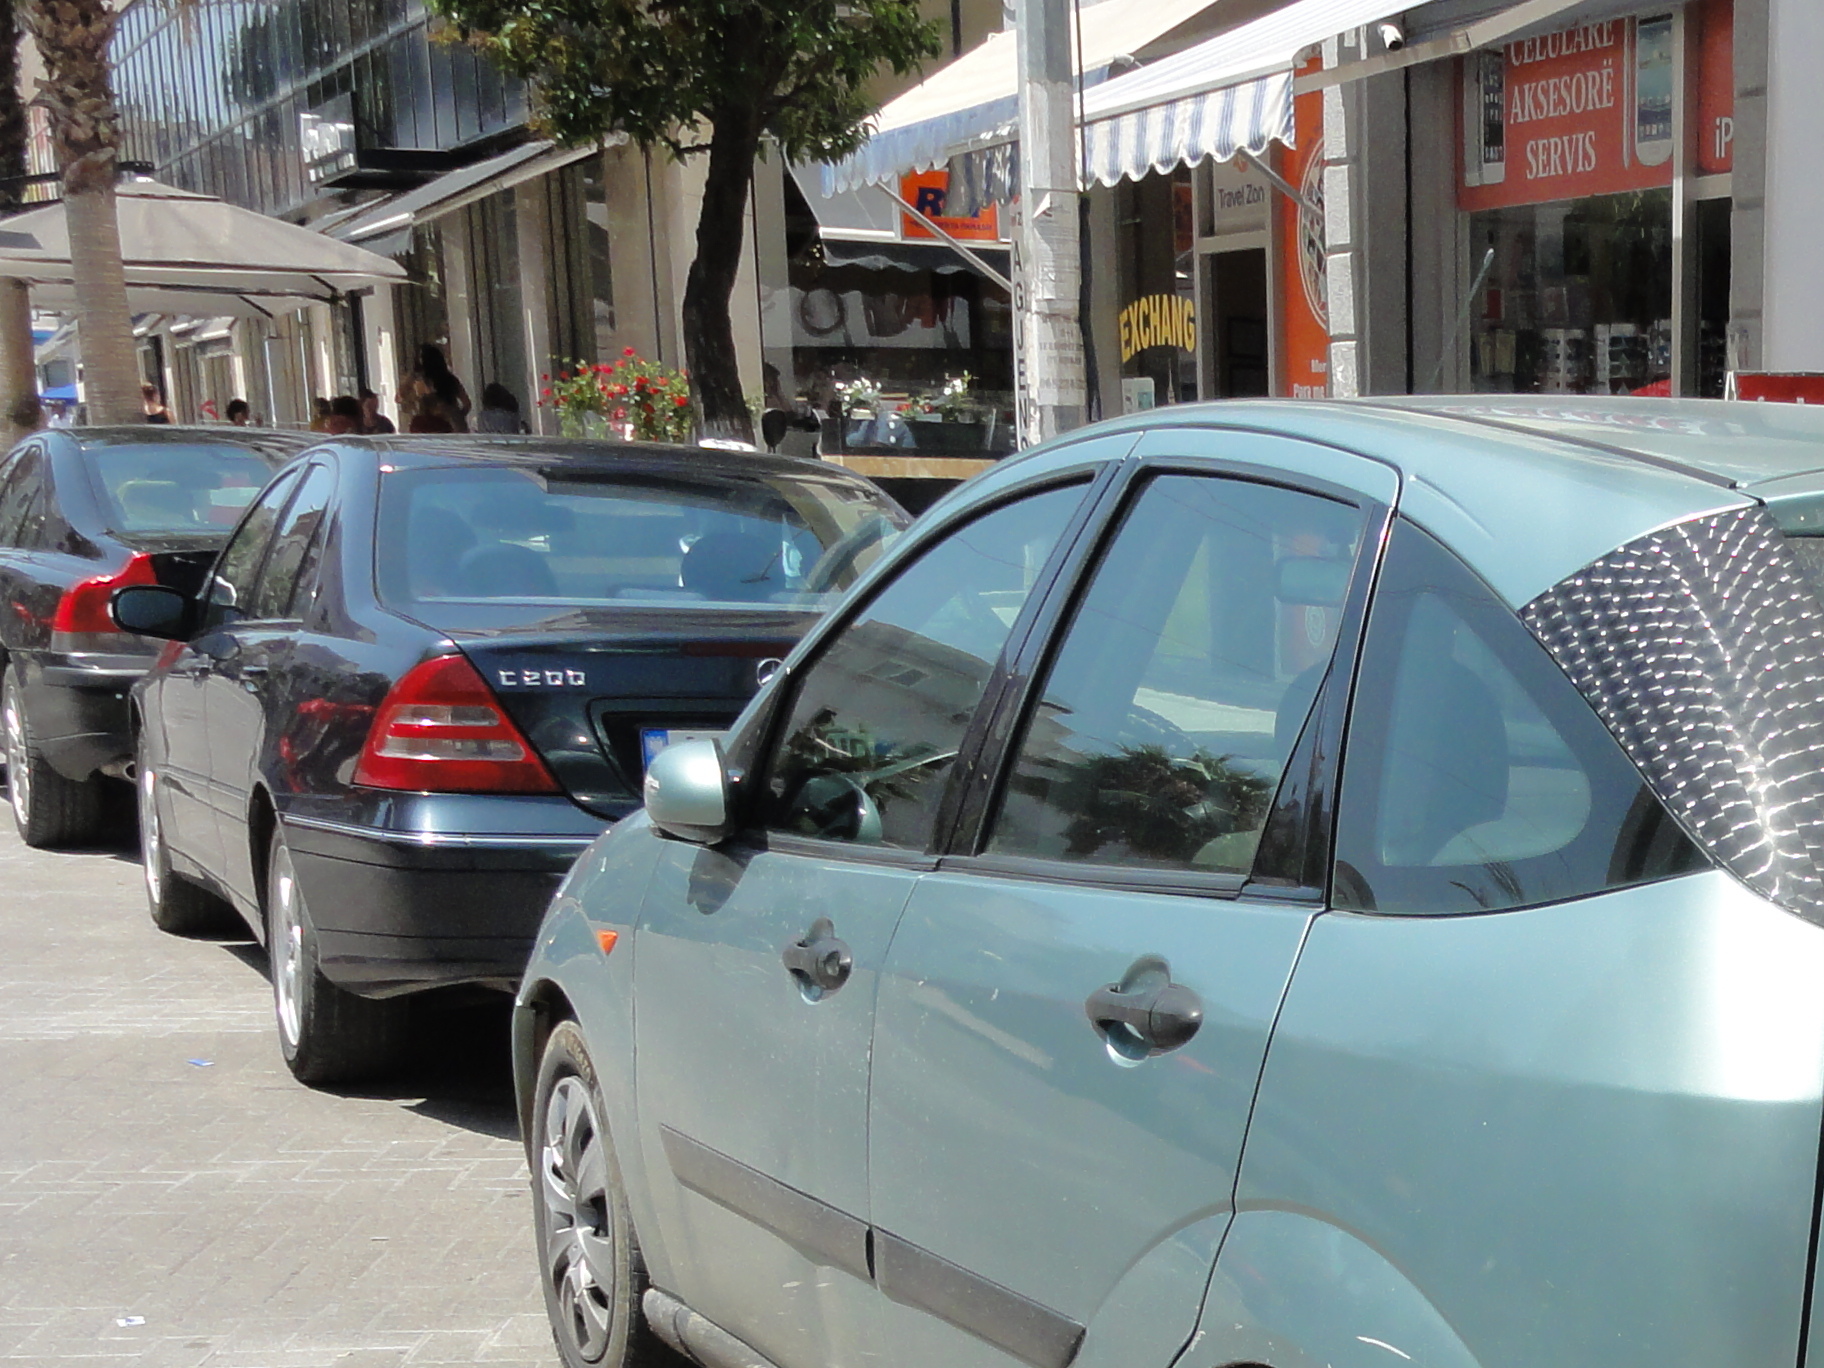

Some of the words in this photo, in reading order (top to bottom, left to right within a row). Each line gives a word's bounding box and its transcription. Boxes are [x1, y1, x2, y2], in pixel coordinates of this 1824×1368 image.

[1509, 58, 1614, 124] AKSESORË
[1526, 130, 1596, 180] SERVIS
[1218, 185, 1245, 210] Travel
[1119, 294, 1196, 363] EXCHANG
